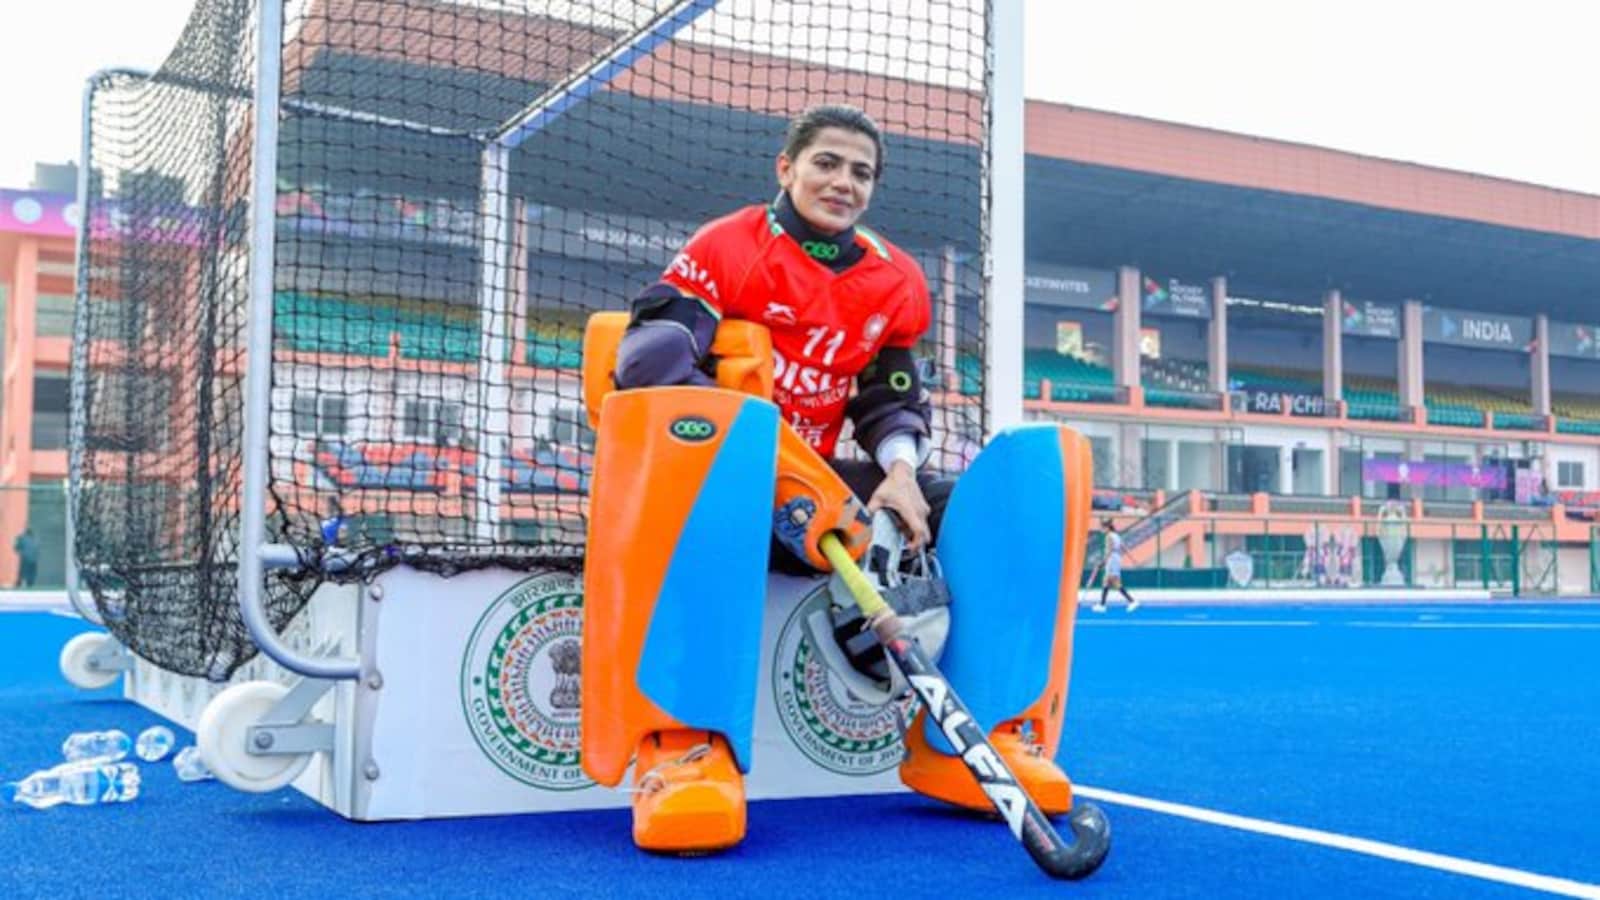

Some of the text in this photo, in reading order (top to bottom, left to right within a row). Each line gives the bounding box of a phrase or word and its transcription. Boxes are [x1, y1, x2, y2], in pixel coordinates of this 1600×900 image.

[802, 325, 846, 366] 11
[1462, 319, 1513, 343] INDIA
[1255, 391, 1324, 414] RACHI
[471, 697, 560, 780] GOVERNMENT
